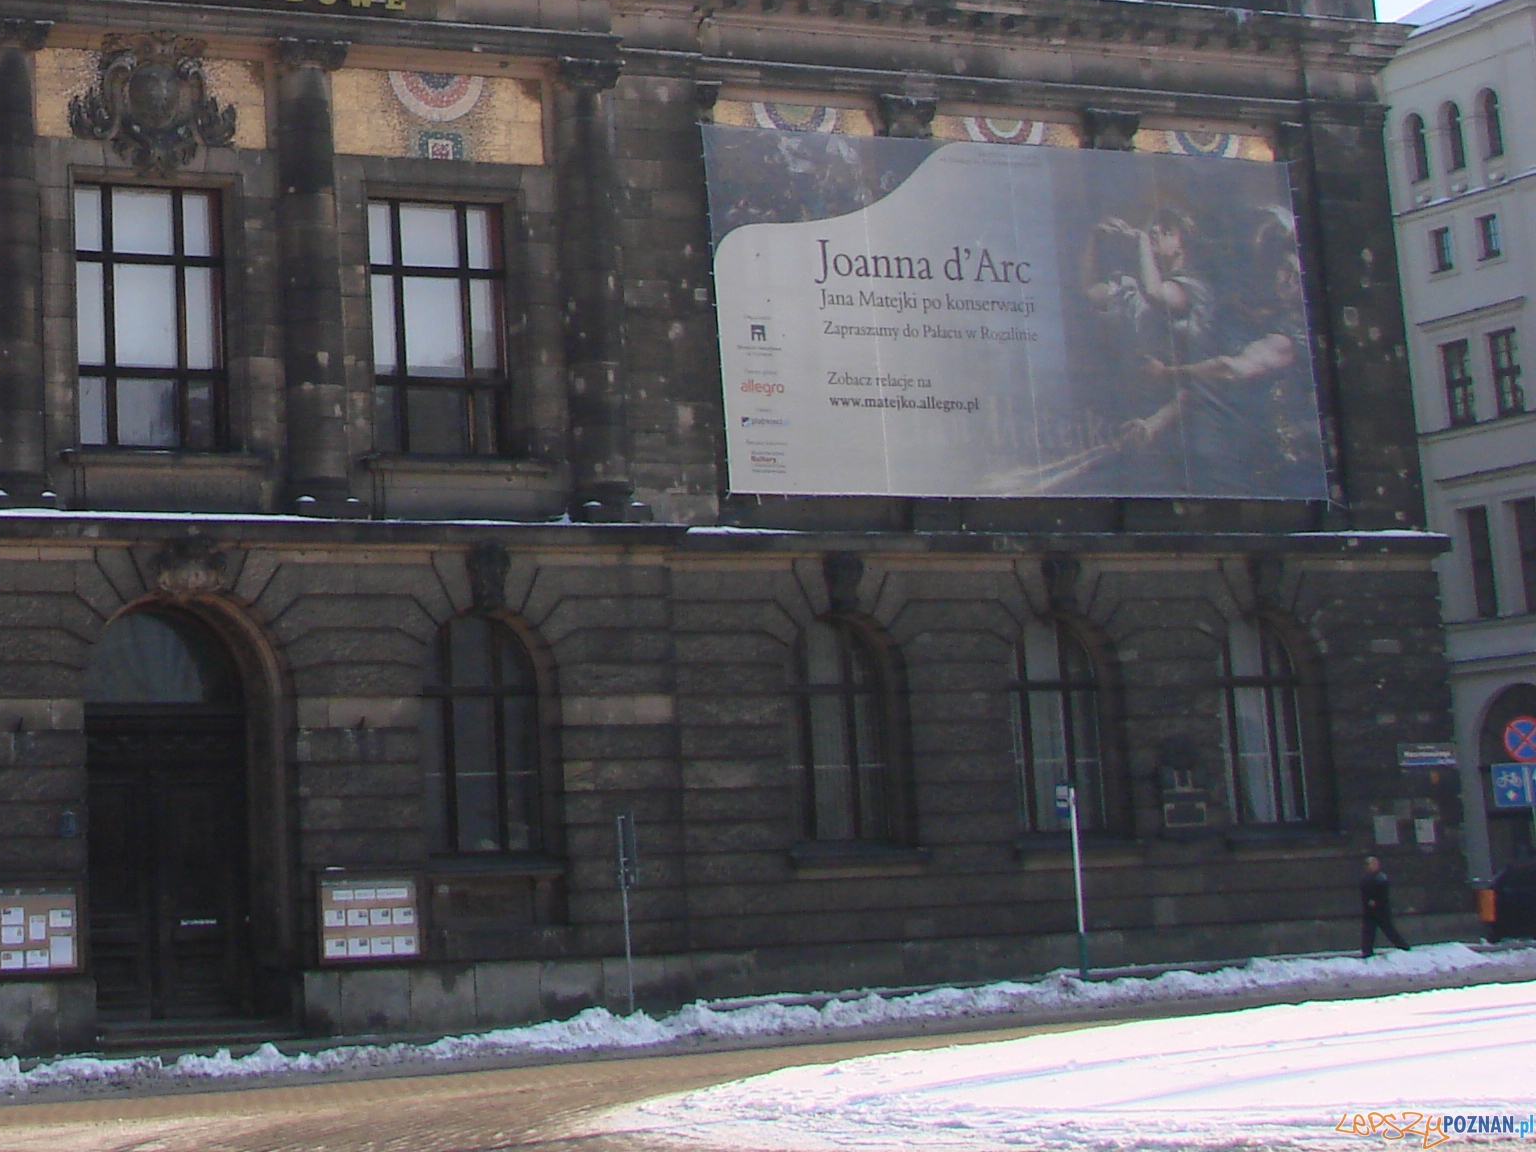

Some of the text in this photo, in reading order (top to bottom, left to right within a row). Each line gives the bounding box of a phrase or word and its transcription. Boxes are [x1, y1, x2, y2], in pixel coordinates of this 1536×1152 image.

[814, 239, 933, 284] Joanna
[819, 289, 1035, 317] Jana Matejki po konserwacji
[823, 320, 1038, 344] Zapraszamy do Pałacu w Rogalinie
[740, 379, 785, 397] allegro
[827, 371, 872, 386] Zobacz
[917, 377, 932, 388] na
[829, 395, 980, 413] www.matejko.allegro.pl
